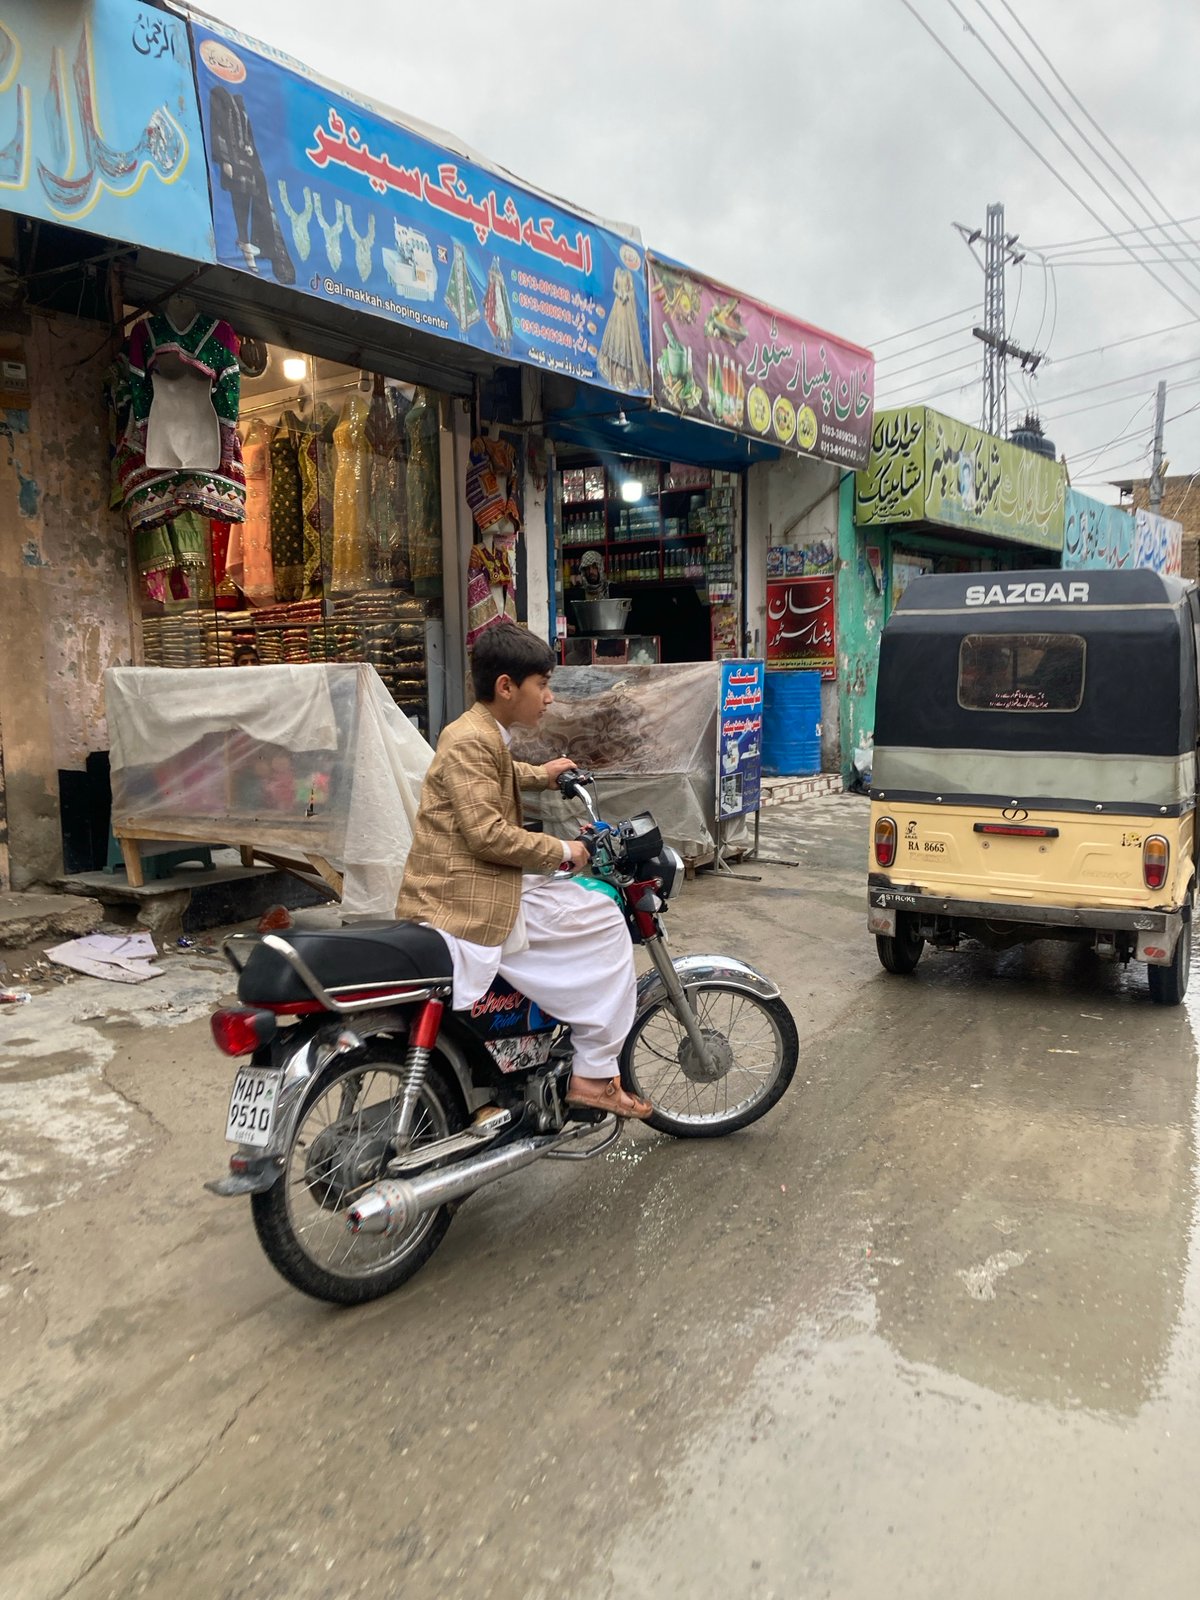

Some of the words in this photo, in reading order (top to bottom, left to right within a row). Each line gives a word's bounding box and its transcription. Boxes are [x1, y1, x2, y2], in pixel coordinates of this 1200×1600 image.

[306, 108, 424, 202] سینٹر
[424, 163, 522, 246] شاپنگ
[323, 278, 449, 331] @al.makkah.shoping.center
[746, 314, 793, 380] سٹور
[834, 365, 872, 421] خان
[768, 586, 832, 620] خان
[965, 582, 1090, 606] SAZGAR
[768, 618, 818, 647] سٹور
[805, 621, 832, 648] پنسار
[908, 841, 920, 851] RA
[924, 842, 945, 853] 8665
[233, 1078, 265, 1103] MAP
[229, 1104, 271, 1132] 9510
